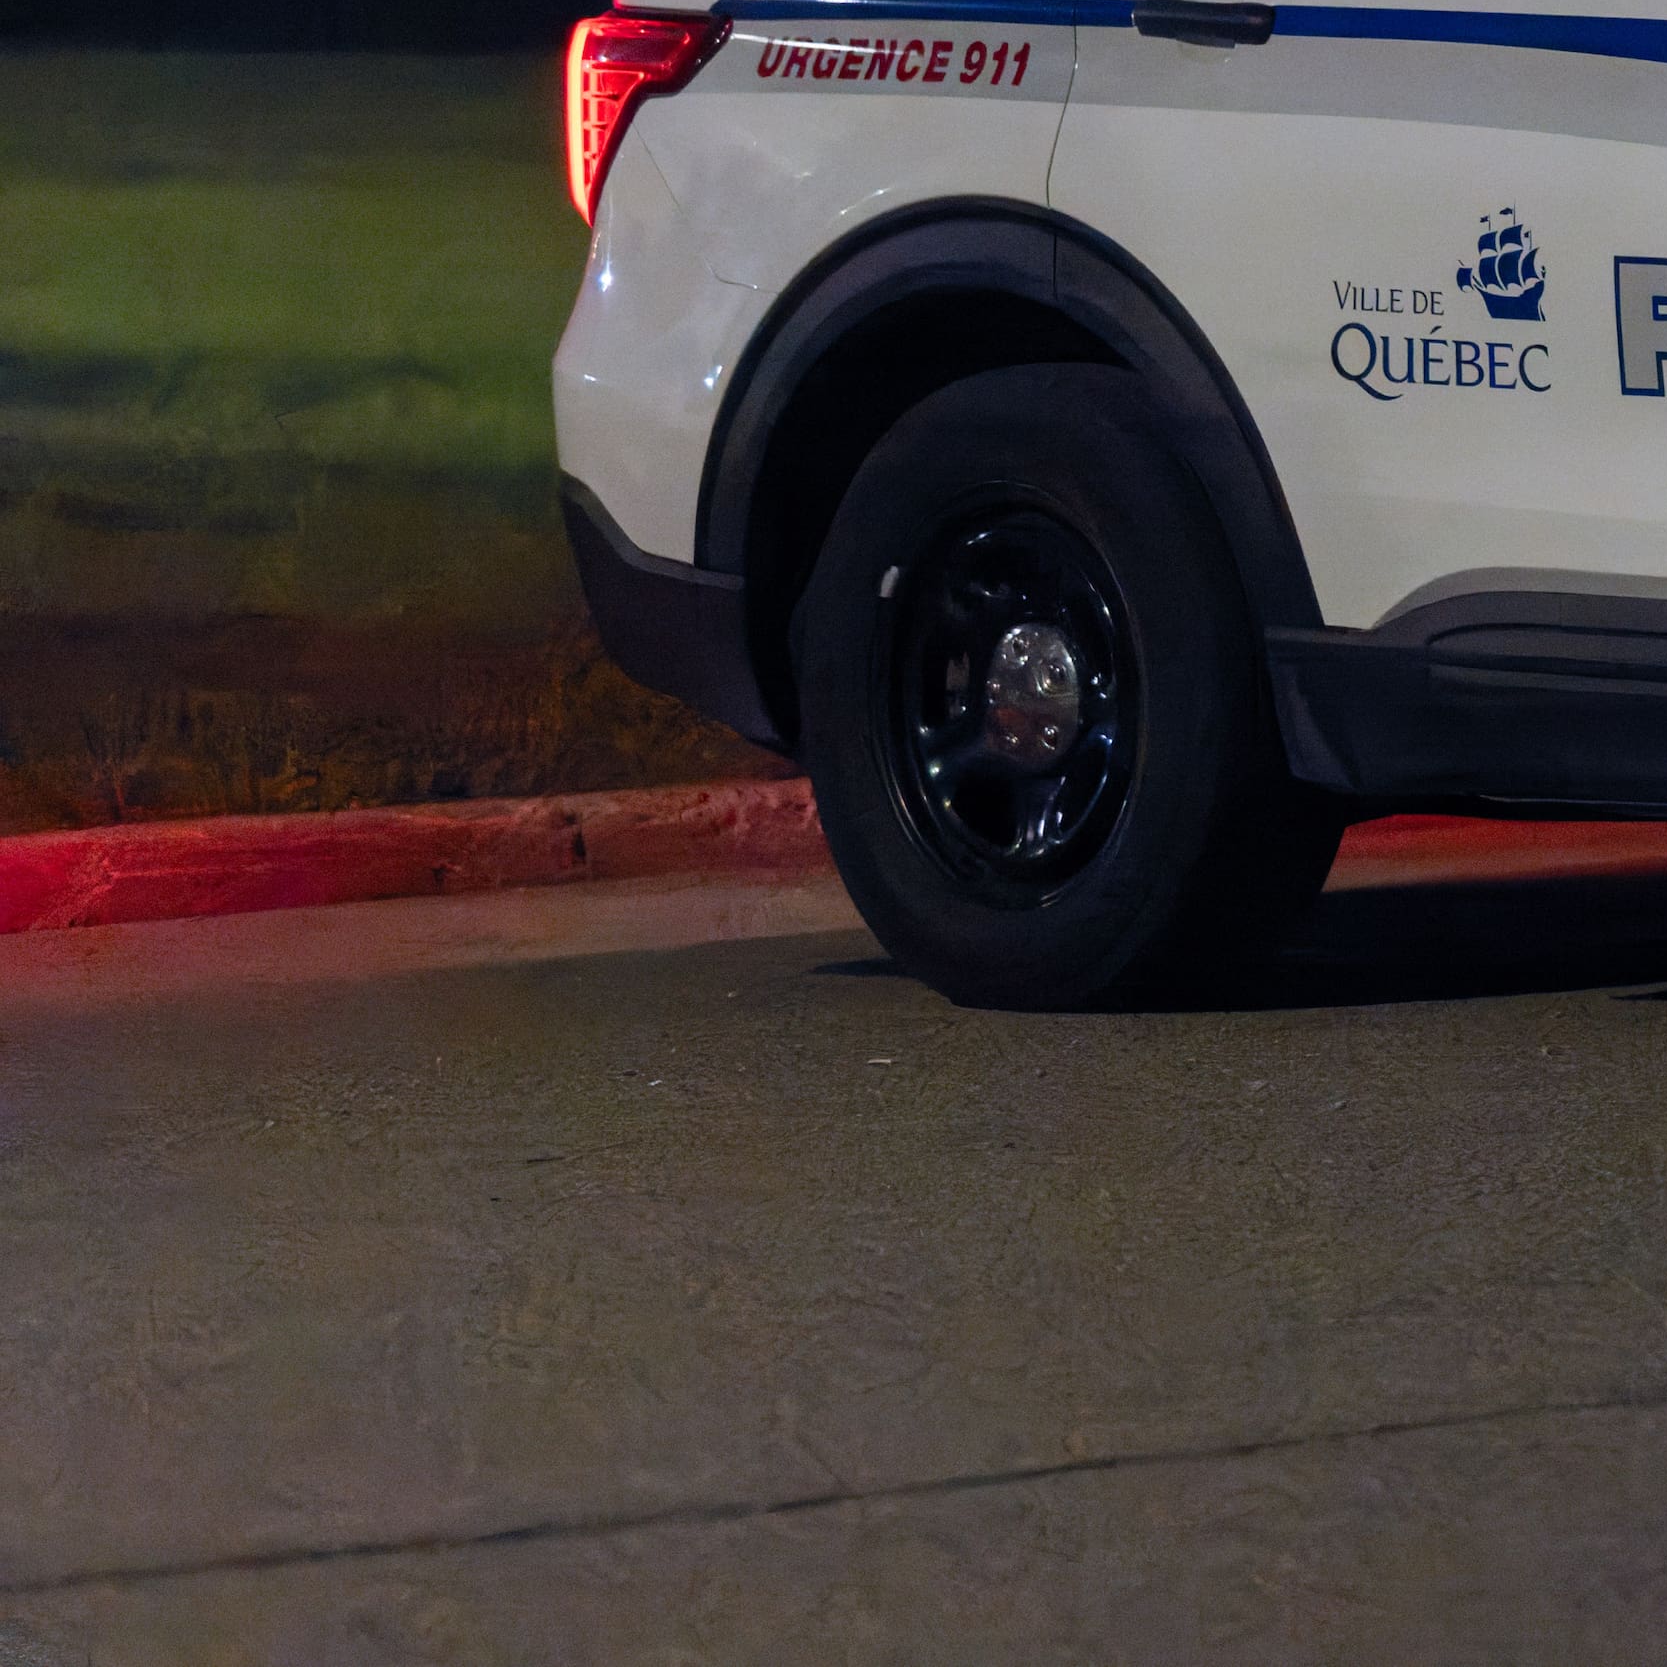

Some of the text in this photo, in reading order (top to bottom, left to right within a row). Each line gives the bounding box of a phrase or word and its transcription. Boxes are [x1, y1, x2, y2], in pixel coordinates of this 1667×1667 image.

[756, 36, 1031, 87] URGENCE 911
[1332, 280, 1445, 316] VILLE DE
[1330, 322, 1552, 401] QUÉBEC
